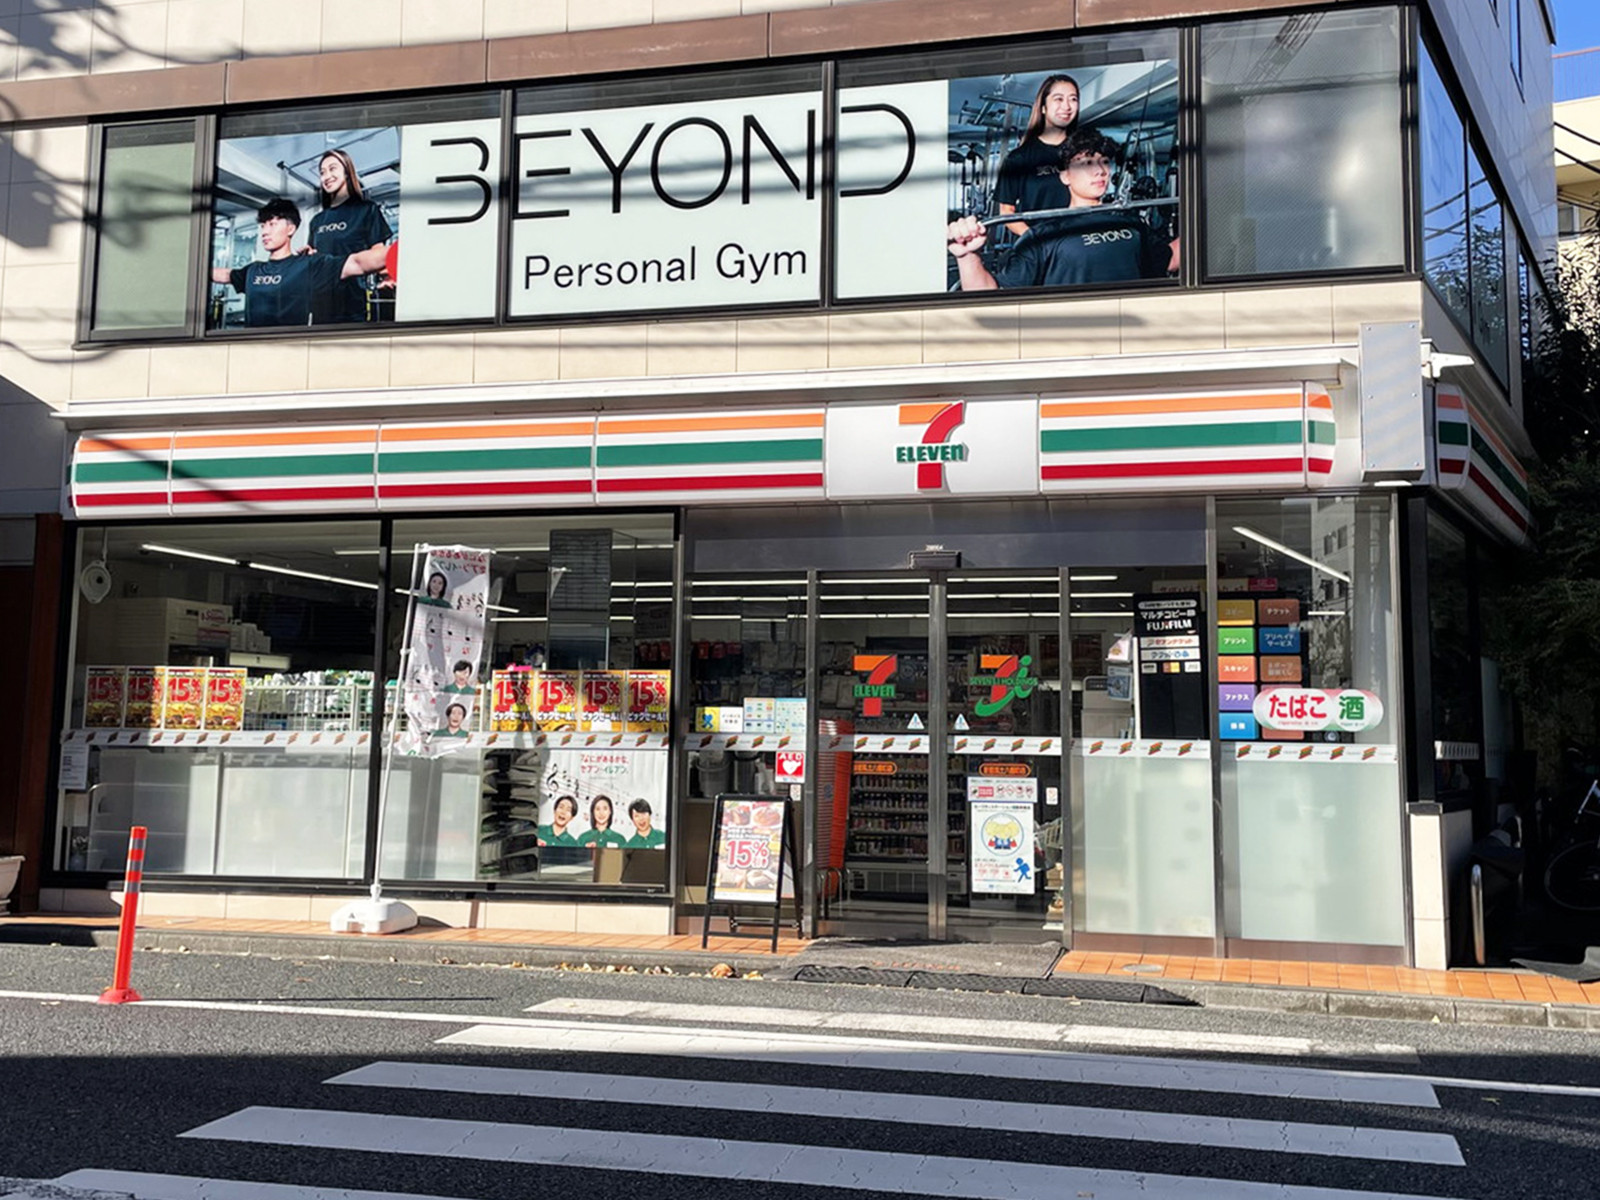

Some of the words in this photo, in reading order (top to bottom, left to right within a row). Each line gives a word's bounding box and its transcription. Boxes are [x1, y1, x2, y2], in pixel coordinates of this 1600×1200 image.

[426, 102, 917, 226] BEYOND
[317, 221, 348, 234] BEYOND
[1081, 229, 1133, 246] BEYOND
[524, 245, 696, 290] Personal
[715, 243, 807, 284] Gym
[1146, 619, 1193, 631] FUJIFILM
[1268, 694, 1328, 719] たばこ
[1338, 695, 1365, 720] 酒
[779, 752, 805, 761] AED
[727, 840, 769, 867] 15%
